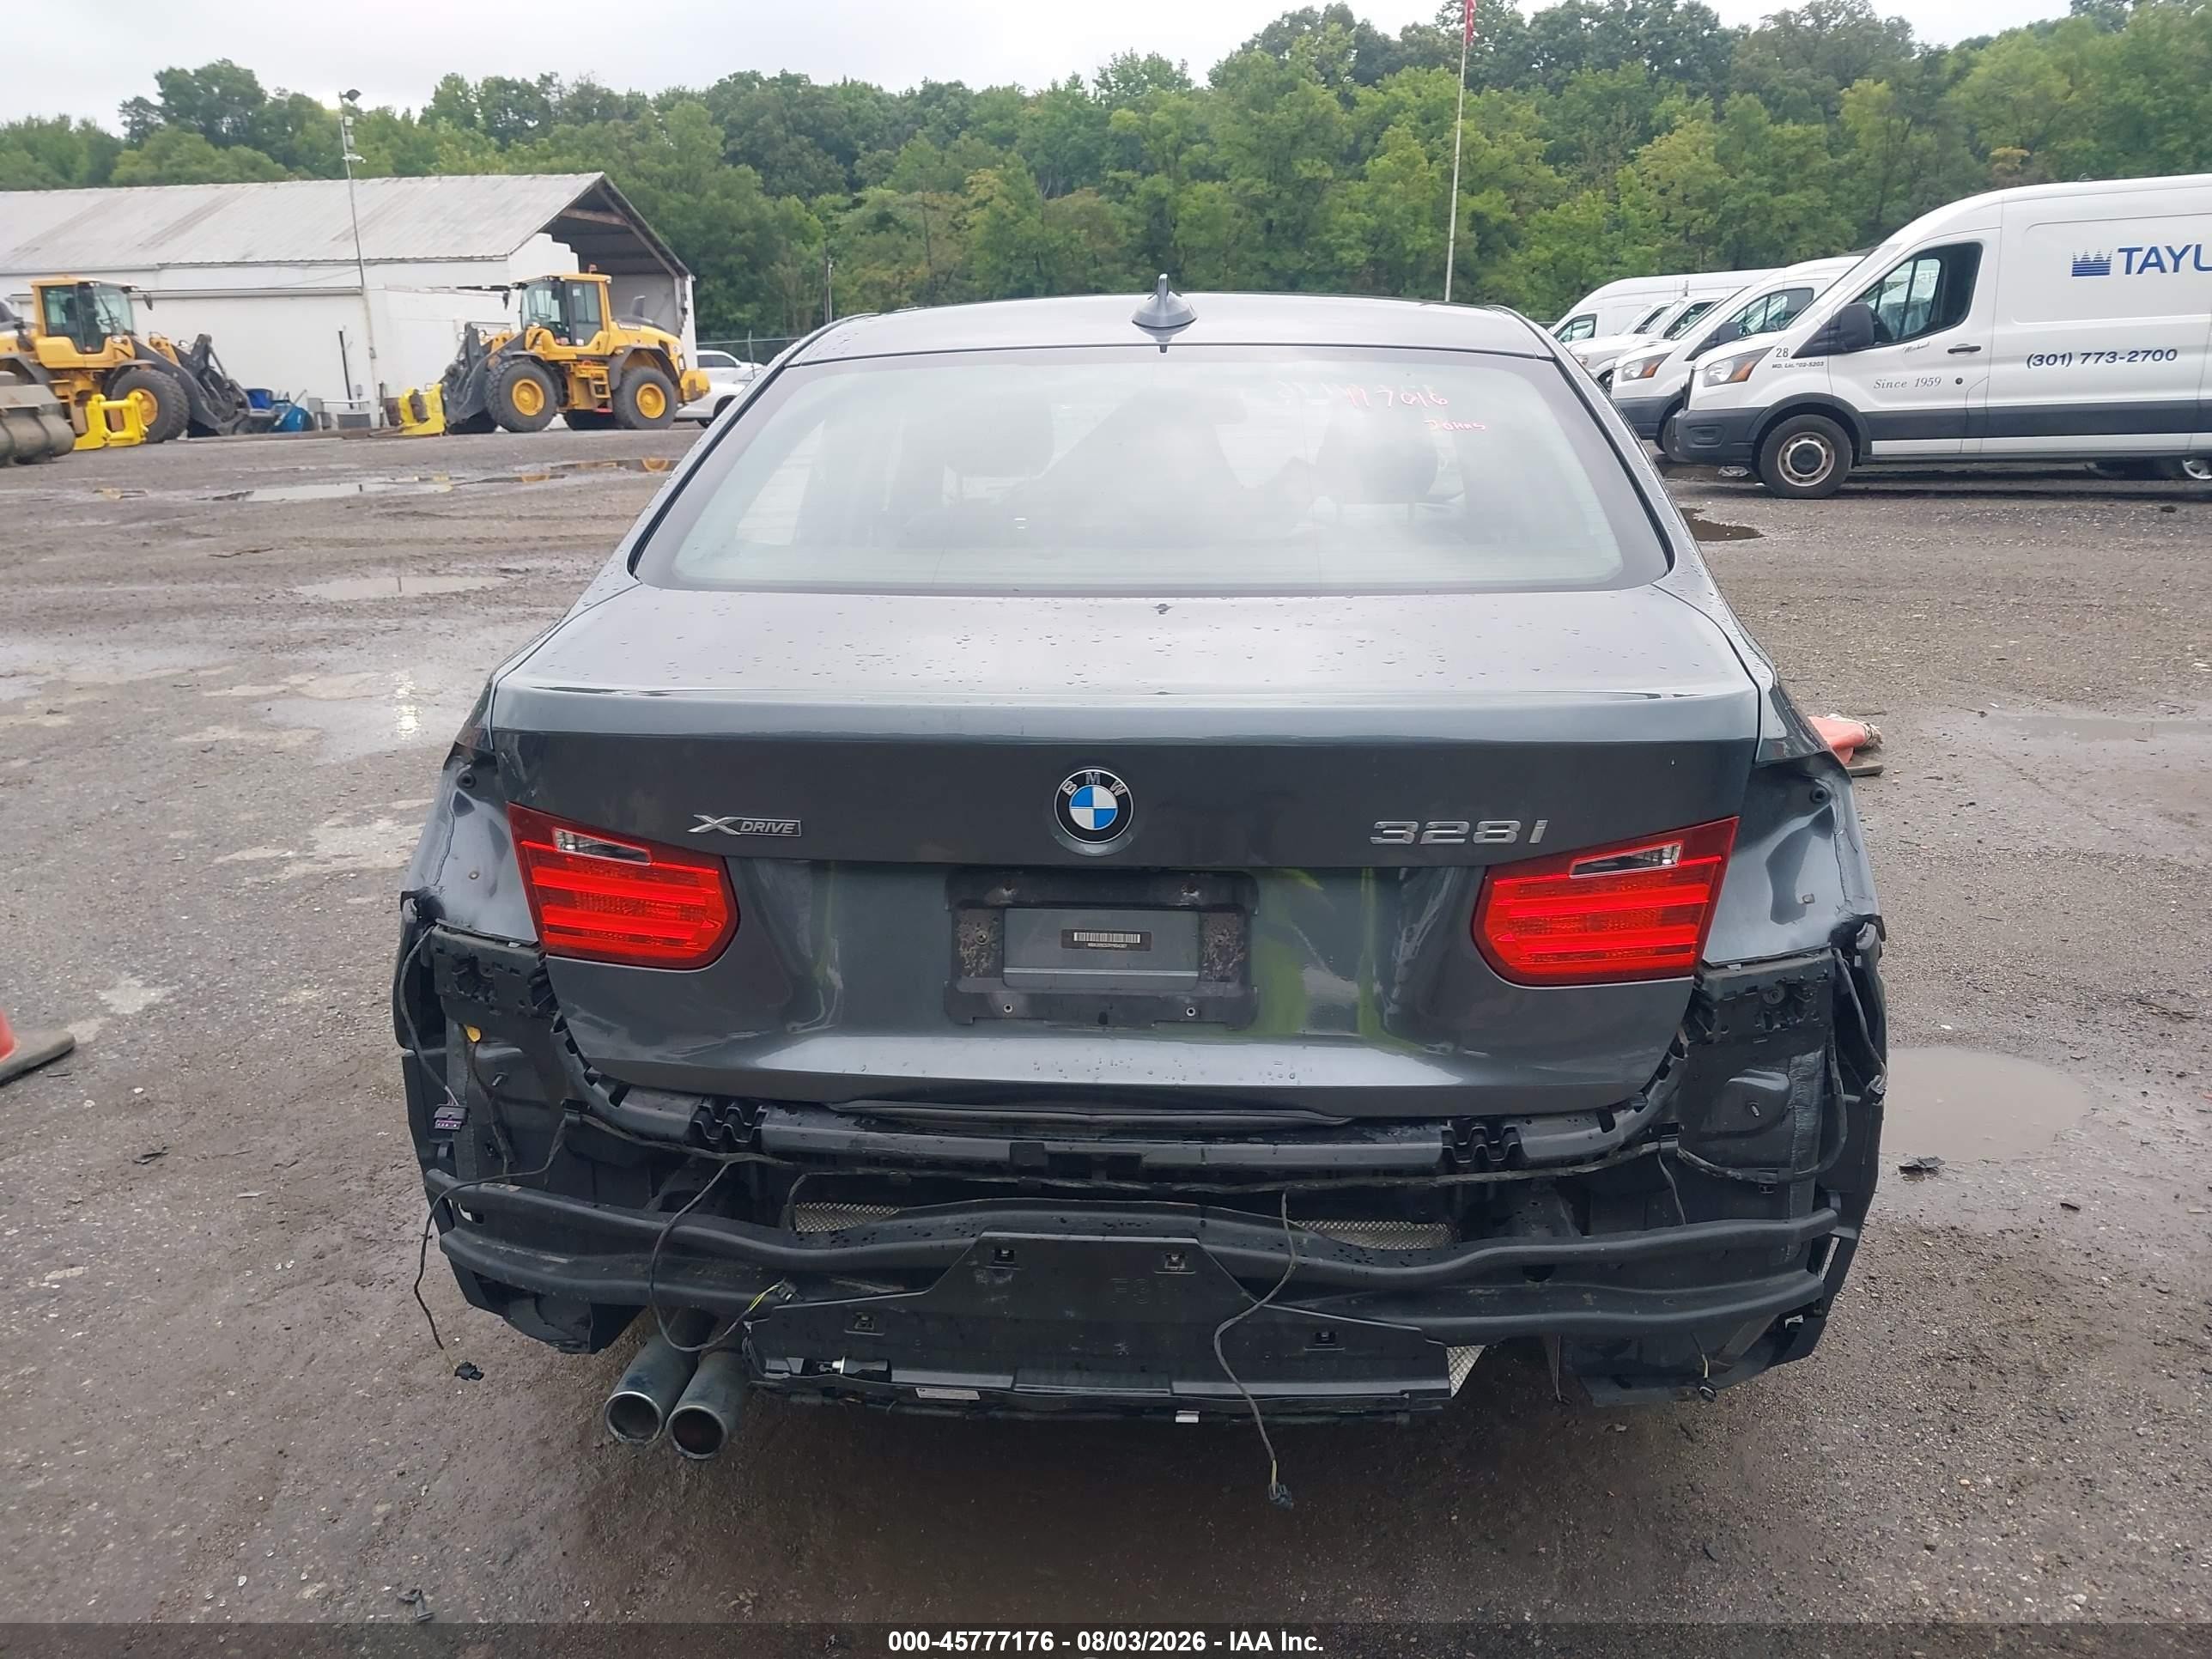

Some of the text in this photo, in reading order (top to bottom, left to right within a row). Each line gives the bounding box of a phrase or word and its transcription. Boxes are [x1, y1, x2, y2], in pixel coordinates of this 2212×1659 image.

[1776, 347, 1789, 358] 28
[2027, 349, 2178, 368] (301) 773-2700
[1873, 376, 1942, 389] Since 1959
[1061, 772, 1127, 797] BMW
[1370, 820, 1548, 844] 328i
